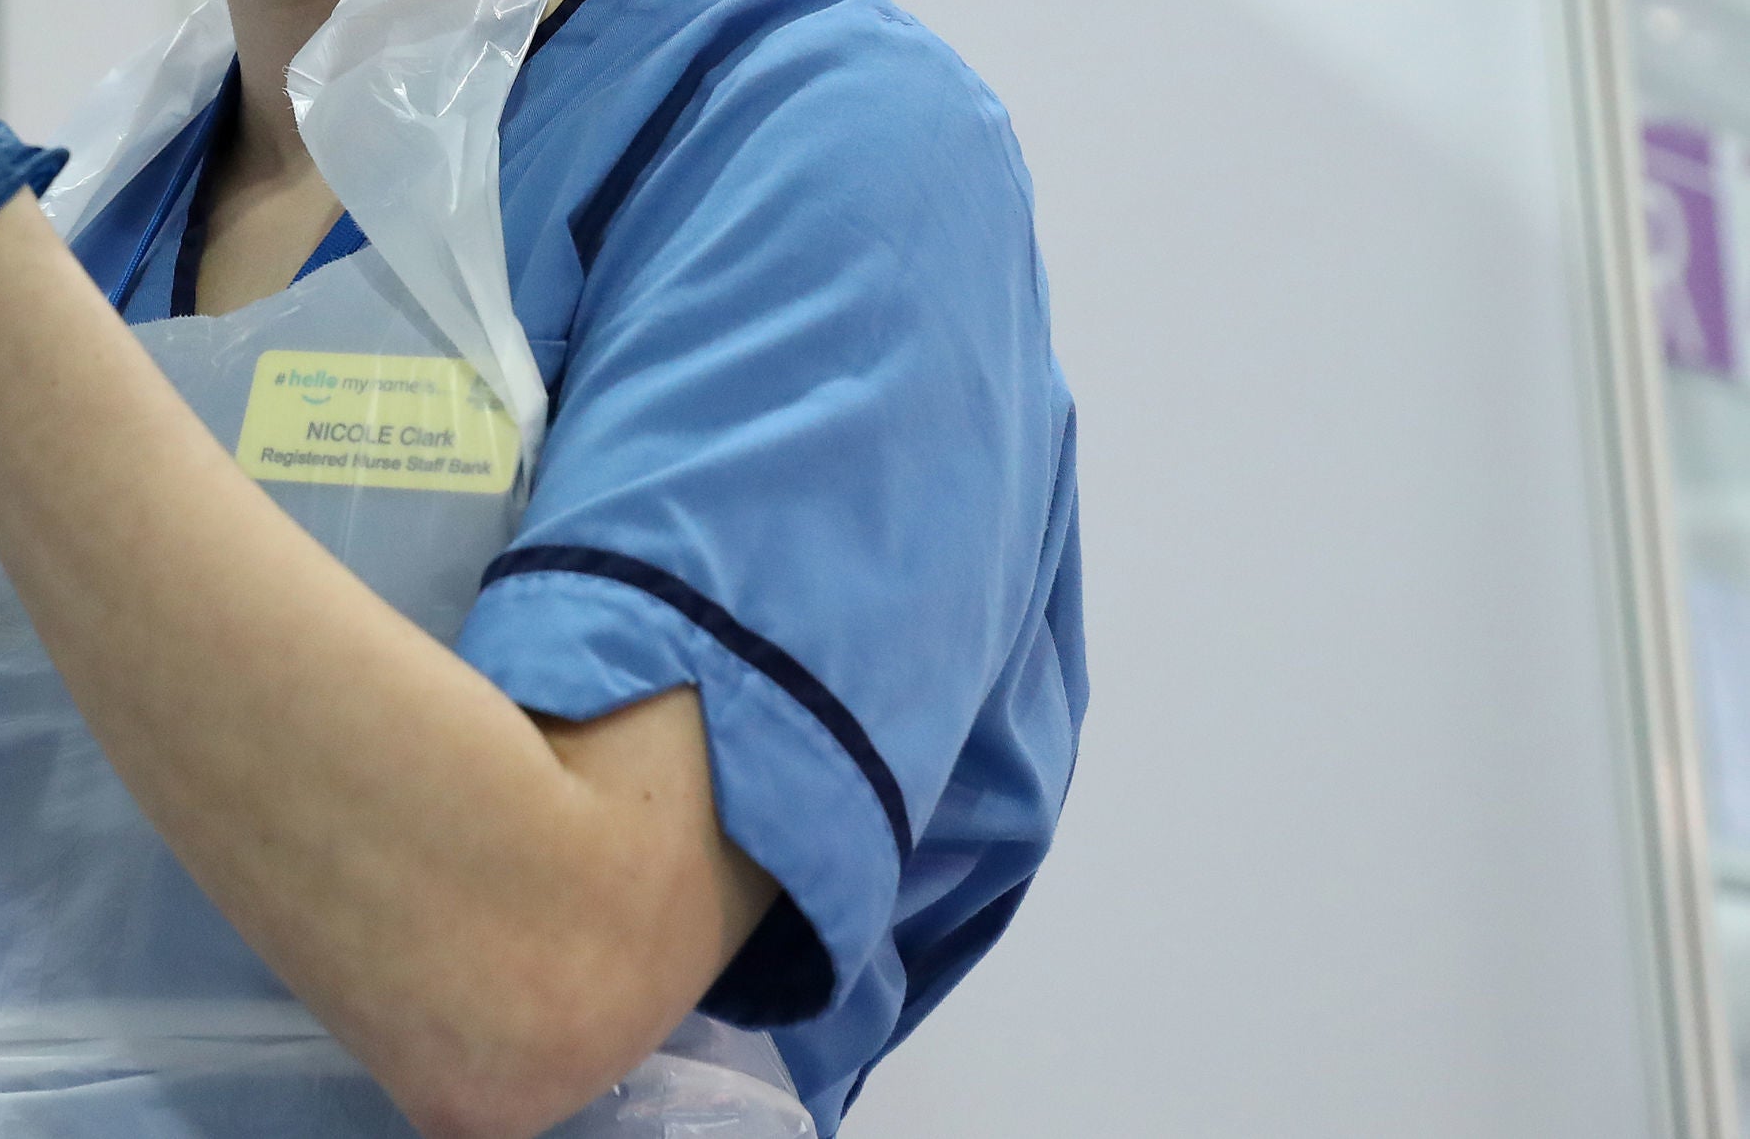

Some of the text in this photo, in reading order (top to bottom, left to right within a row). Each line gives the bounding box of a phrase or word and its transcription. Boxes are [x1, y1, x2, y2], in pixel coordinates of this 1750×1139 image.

[342, 378, 369, 395] my
[306, 421, 456, 448] NICOLE Clark
[261, 447, 491, 475] Registered Nurse Staff Bank
